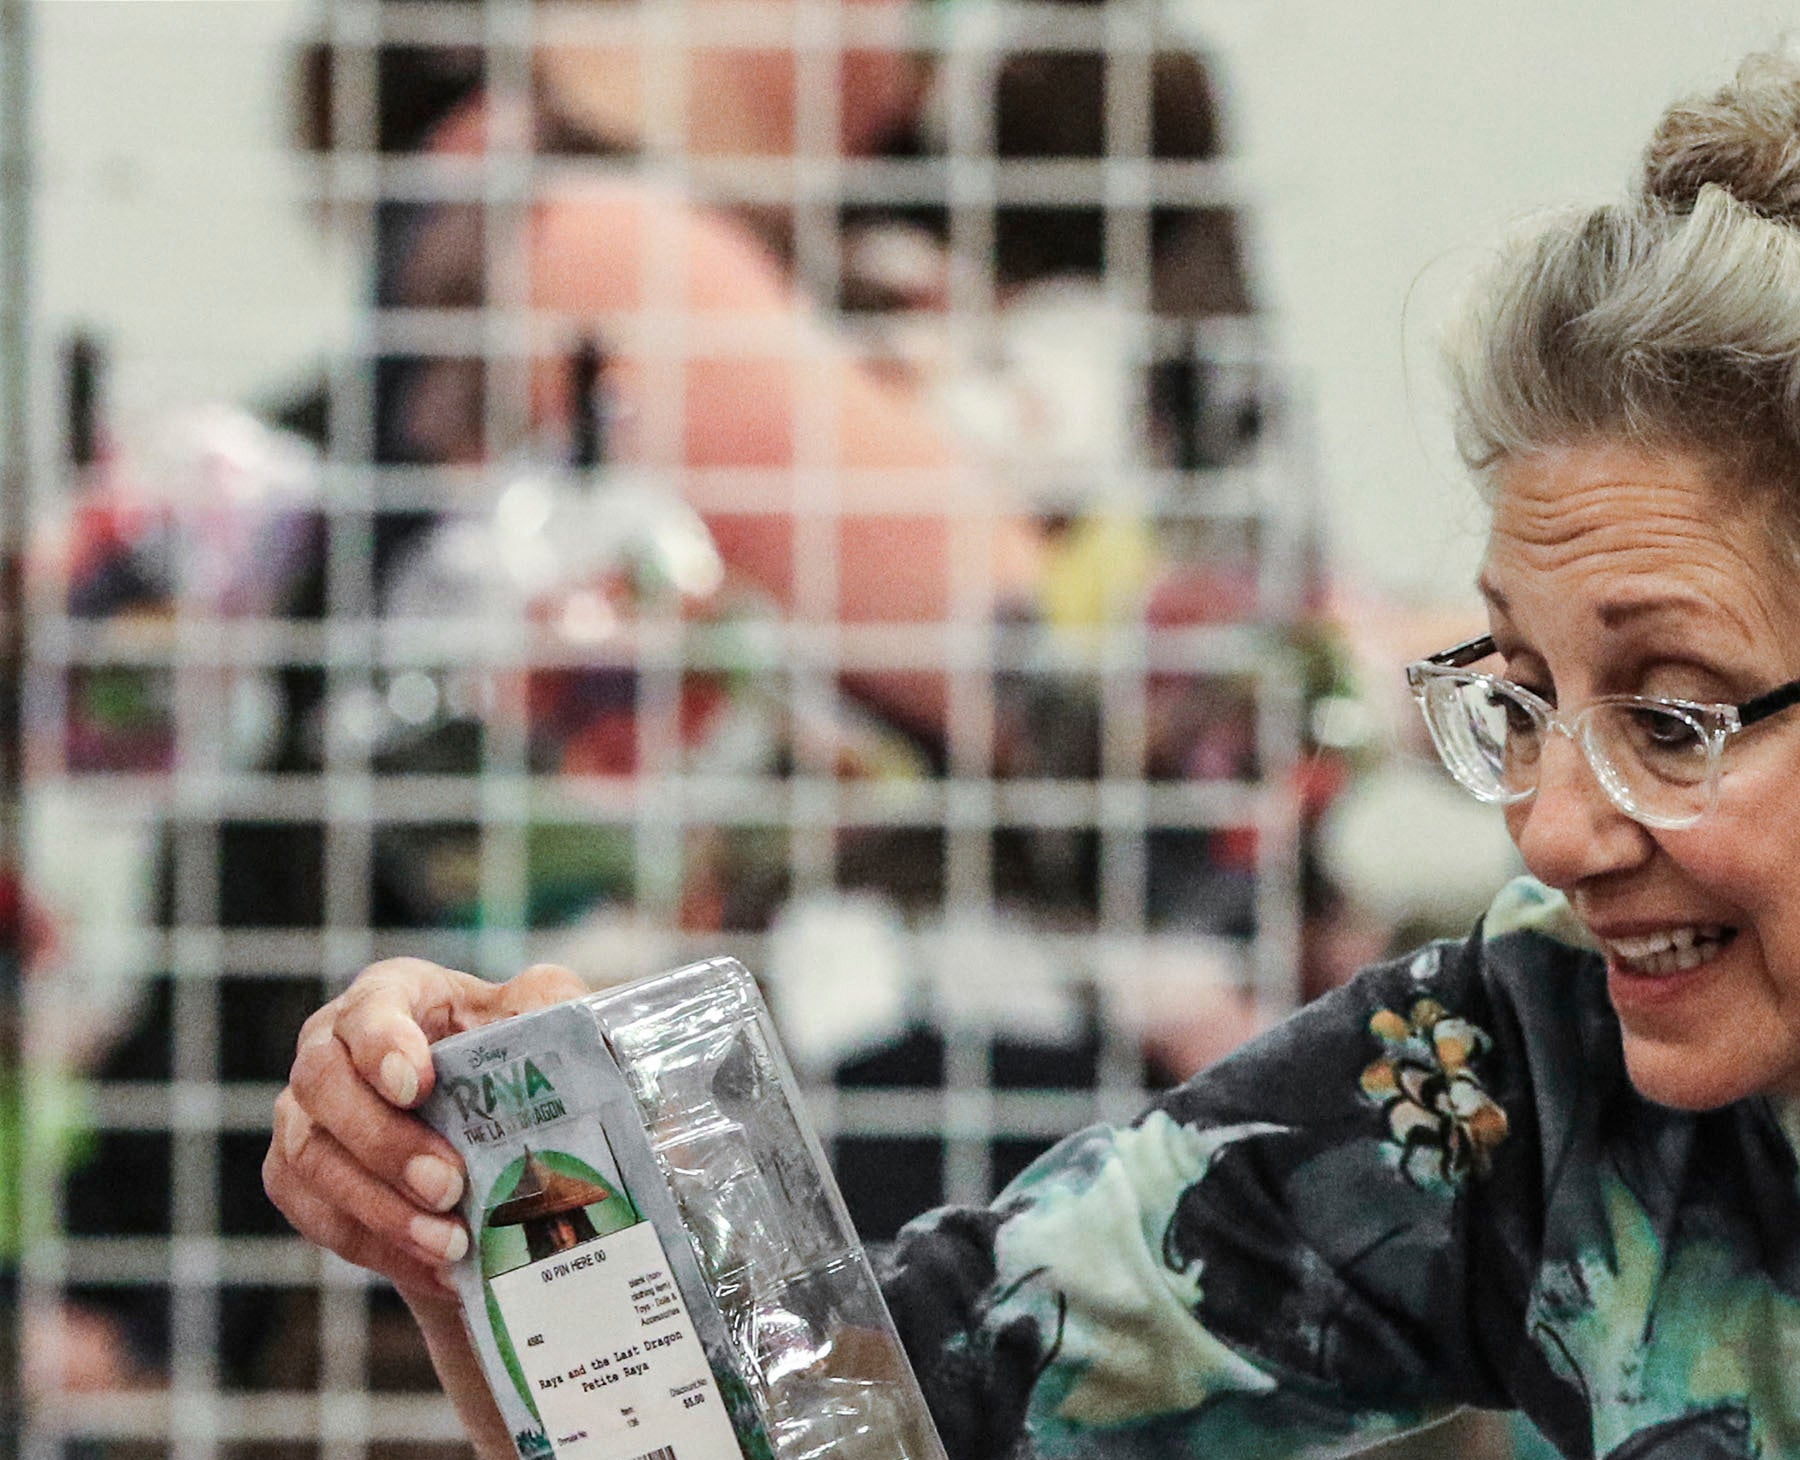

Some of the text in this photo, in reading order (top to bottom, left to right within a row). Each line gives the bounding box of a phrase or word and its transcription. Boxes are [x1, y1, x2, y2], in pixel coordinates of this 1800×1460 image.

[464, 1123, 486, 1145] THE
[554, 1262, 570, 1280] PIN
[571, 1253, 594, 1273] HERE
[634, 1302, 651, 1315] Toys
[640, 1306, 681, 1327] Accessories
[538, 1330, 683, 1390] Raya and the Last Dragon
[581, 1361, 650, 1393] Petite Raya
[682, 1392, 706, 1410] $5.00
